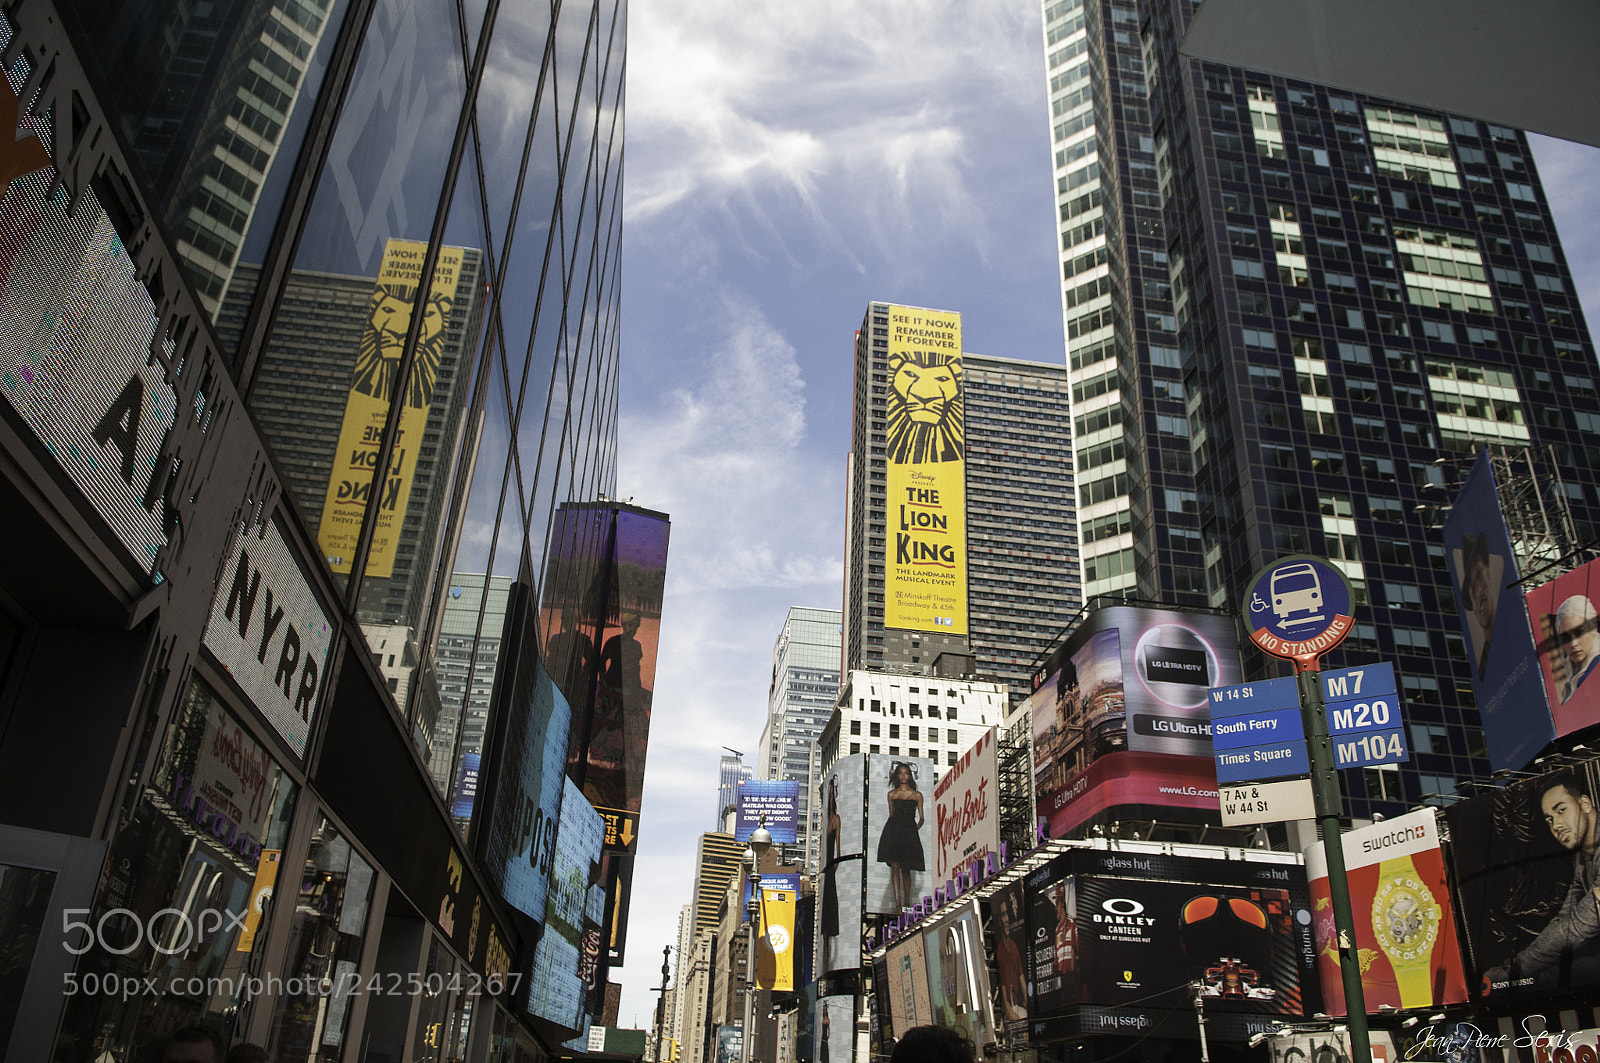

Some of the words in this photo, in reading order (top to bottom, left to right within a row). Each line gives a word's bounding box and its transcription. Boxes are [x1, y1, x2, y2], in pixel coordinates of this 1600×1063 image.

[893, 315, 910, 326] SEE
[913, 316, 922, 326] IT
[926, 318, 959, 332] NOW.
[896, 327, 955, 341] REMEMBER
[894, 335, 903, 343] IT
[907, 337, 959, 350] FOREVER.
[907, 470, 936, 483] Disney
[906, 487, 940, 504] THE
[900, 504, 948, 531] LION
[896, 532, 956, 565] KING
[895, 575, 929, 585] MUSICAL
[896, 568, 911, 576] THE
[912, 570, 956, 580] LANDMARK
[897, 600, 930, 611] Broadway
[939, 602, 954, 611] 45th
[904, 592, 931, 602] Minskoff
[933, 594, 956, 604] Theatre
[224, 546, 318, 727] NYRR
[1258, 632, 1279, 651] NO
[1280, 619, 1347, 657] STANDING
[1039, 669, 1047, 684] LG
[1327, 670, 1365, 698] M7
[1213, 691, 1225, 703] W
[1226, 689, 1241, 701] 14
[1242, 686, 1254, 699] St
[1332, 701, 1391, 731] M20
[1152, 720, 1168, 736] LG
[1170, 720, 1197, 736] Ultra
[1216, 721, 1247, 736] South
[1249, 718, 1279, 735] Ferry
[1337, 733, 1405, 765] M104
[1218, 752, 1250, 767] Times
[1253, 748, 1293, 765] Square
[1159, 785, 1219, 799] www.LG.com
[1223, 790, 1231, 802] 7
[1234, 788, 1248, 801] Av
[1251, 786, 1260, 799] &
[1053, 794, 1062, 810] LG
[1226, 803, 1238, 816] W
[1240, 800, 1254, 814] 44
[1256, 798, 1269, 813] St
[1363, 827, 1416, 853] swatch
[1134, 857, 1151, 871] hut
[1271, 868, 1290, 881] hut
[1406, 879, 1420, 890] 05
[1420, 890, 1429, 902] 10
[1092, 914, 1157, 927] OAKLEY
[1107, 925, 1142, 936] CANTEEN
[1492, 981, 1510, 991] SONY
[1511, 977, 1535, 988] MUSIC
